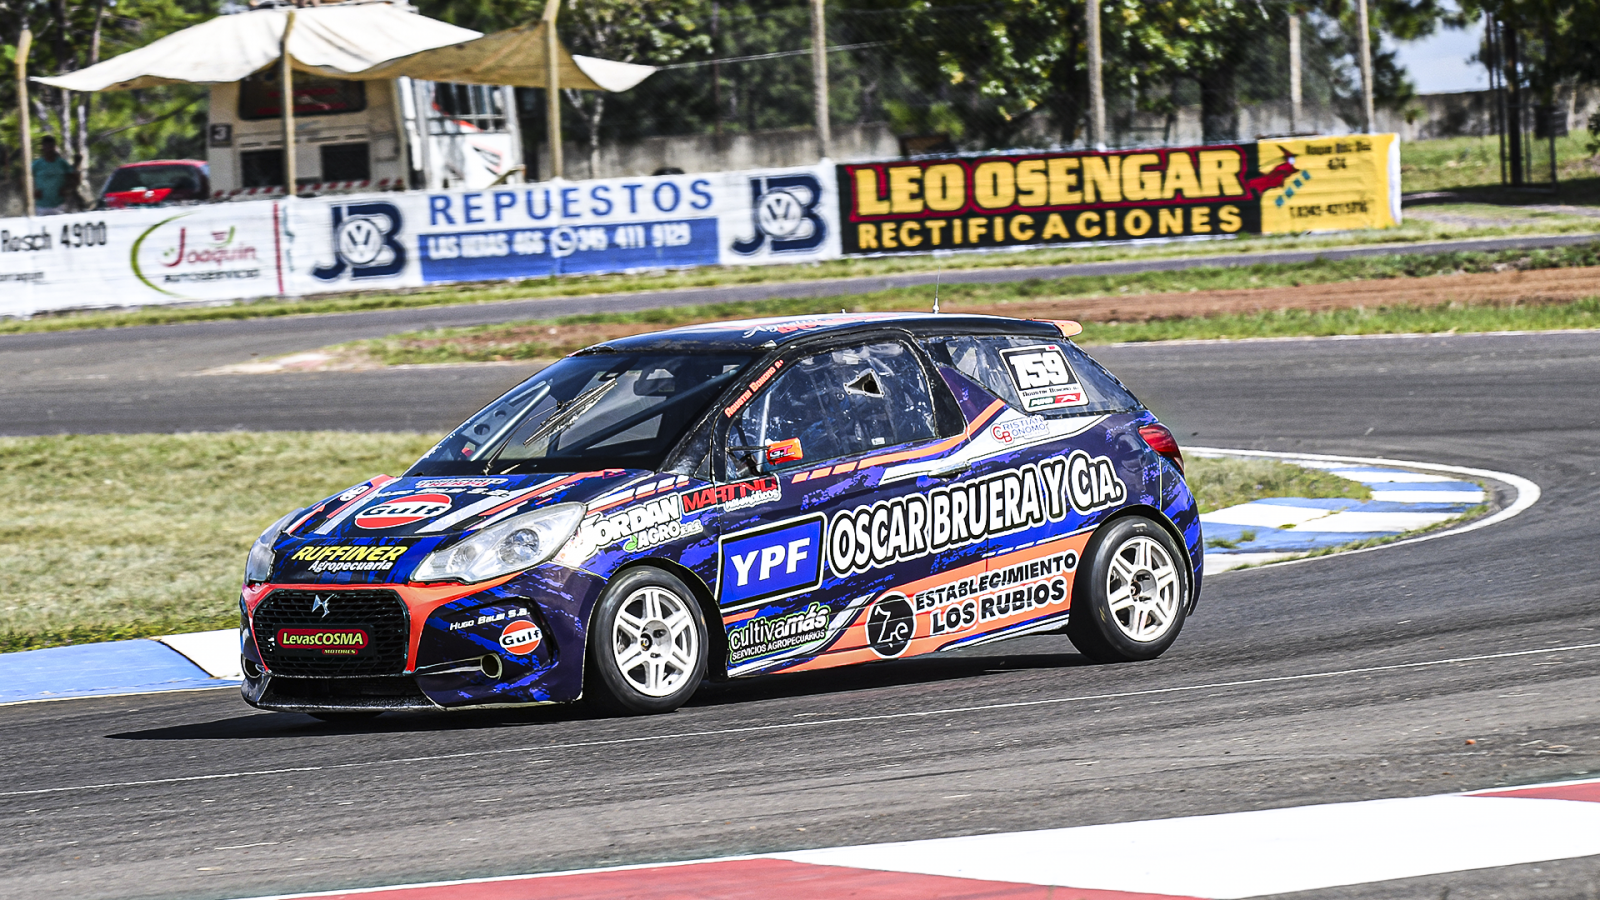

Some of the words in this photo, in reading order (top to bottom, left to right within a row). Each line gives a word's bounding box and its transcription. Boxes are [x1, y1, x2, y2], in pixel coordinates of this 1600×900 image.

[213, 127, 227, 140] 3
[854, 163, 966, 216] LEO
[974, 149, 1244, 210] OSENGAR
[429, 178, 714, 227] REPUESTOS
[61, 221, 106, 248] 4900
[614, 225, 646, 249] 411
[857, 204, 1243, 249] RECTIFICACIONES
[1009, 351, 1069, 389] 159
[361, 504, 446, 516] Gulf
[575, 494, 681, 558] JORDAN
[832, 499, 926, 570] OSCAR
[932, 470, 1042, 548] BRUERA
[1042, 460, 1065, 516] Y
[291, 546, 408, 560] RUFFINER
[637, 520, 681, 549] AGRO
[730, 537, 811, 587] YPF
[915, 552, 1077, 611] ESTABLECIMIENTO
[931, 602, 976, 635] LOS
[980, 578, 1066, 621] RUBIOS
[282, 631, 364, 645] LevasCOSMA
[501, 629, 540, 646] Gulf
[730, 604, 828, 650] cultivamás
[732, 643, 767, 661] SERVICIOS
[767, 628, 825, 651] AGROPECUARIOS
